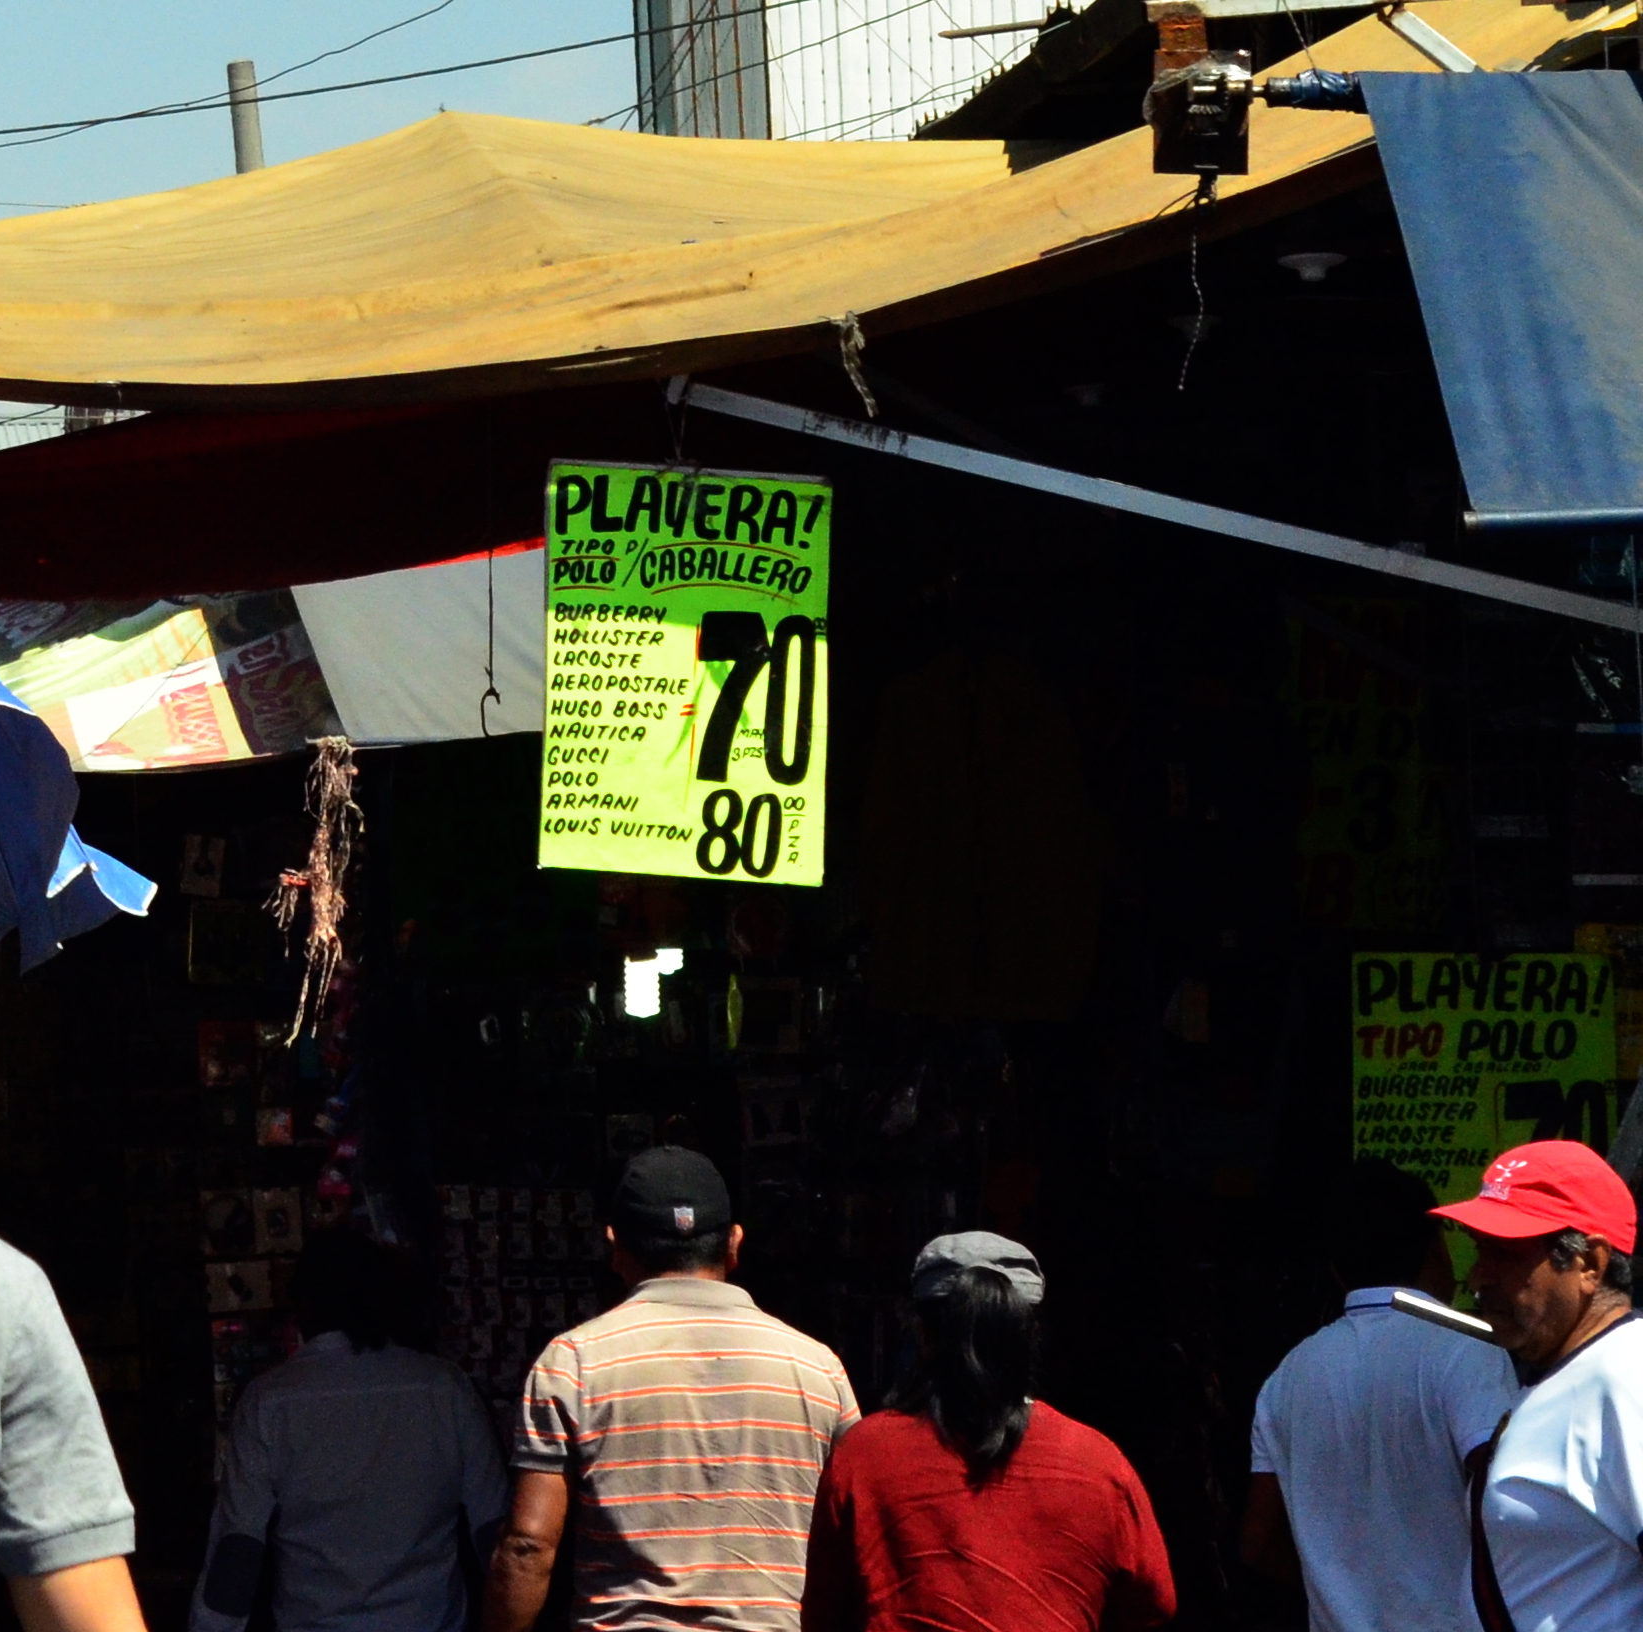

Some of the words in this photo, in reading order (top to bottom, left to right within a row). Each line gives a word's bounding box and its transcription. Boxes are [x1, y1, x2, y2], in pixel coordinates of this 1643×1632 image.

[554, 473, 824, 550] PLAYERA!
[560, 538, 616, 556] TIPO
[553, 559, 617, 585] POLO
[554, 601, 668, 625] BURBERRY
[553, 627, 665, 647] HOLLISTER
[553, 649, 643, 669] LACOSTE
[550, 672, 690, 696] AEROPOSTALE
[550, 698, 603, 718] HUGO
[612, 699, 668, 720] BOSS
[696, 610, 816, 786] 70
[549, 721, 647, 742] NAUTICA
[547, 745, 609, 766] GUCCI
[547, 770, 599, 788] POLO
[545, 792, 639, 813] ARMANI
[543, 816, 602, 836] LOUIS
[610, 819, 694, 843] VUITTON
[696, 788, 783, 879] 80
[1358, 959, 1609, 1017] PLAYERA!
[1356, 1023, 1443, 1058] TIPO
[1458, 1019, 1578, 1061] POLO
[1358, 1074, 1480, 1099] BURBERRY
[1356, 1101, 1477, 1122] HOLLISTER
[1357, 1125, 1456, 1144] LACOSTE
